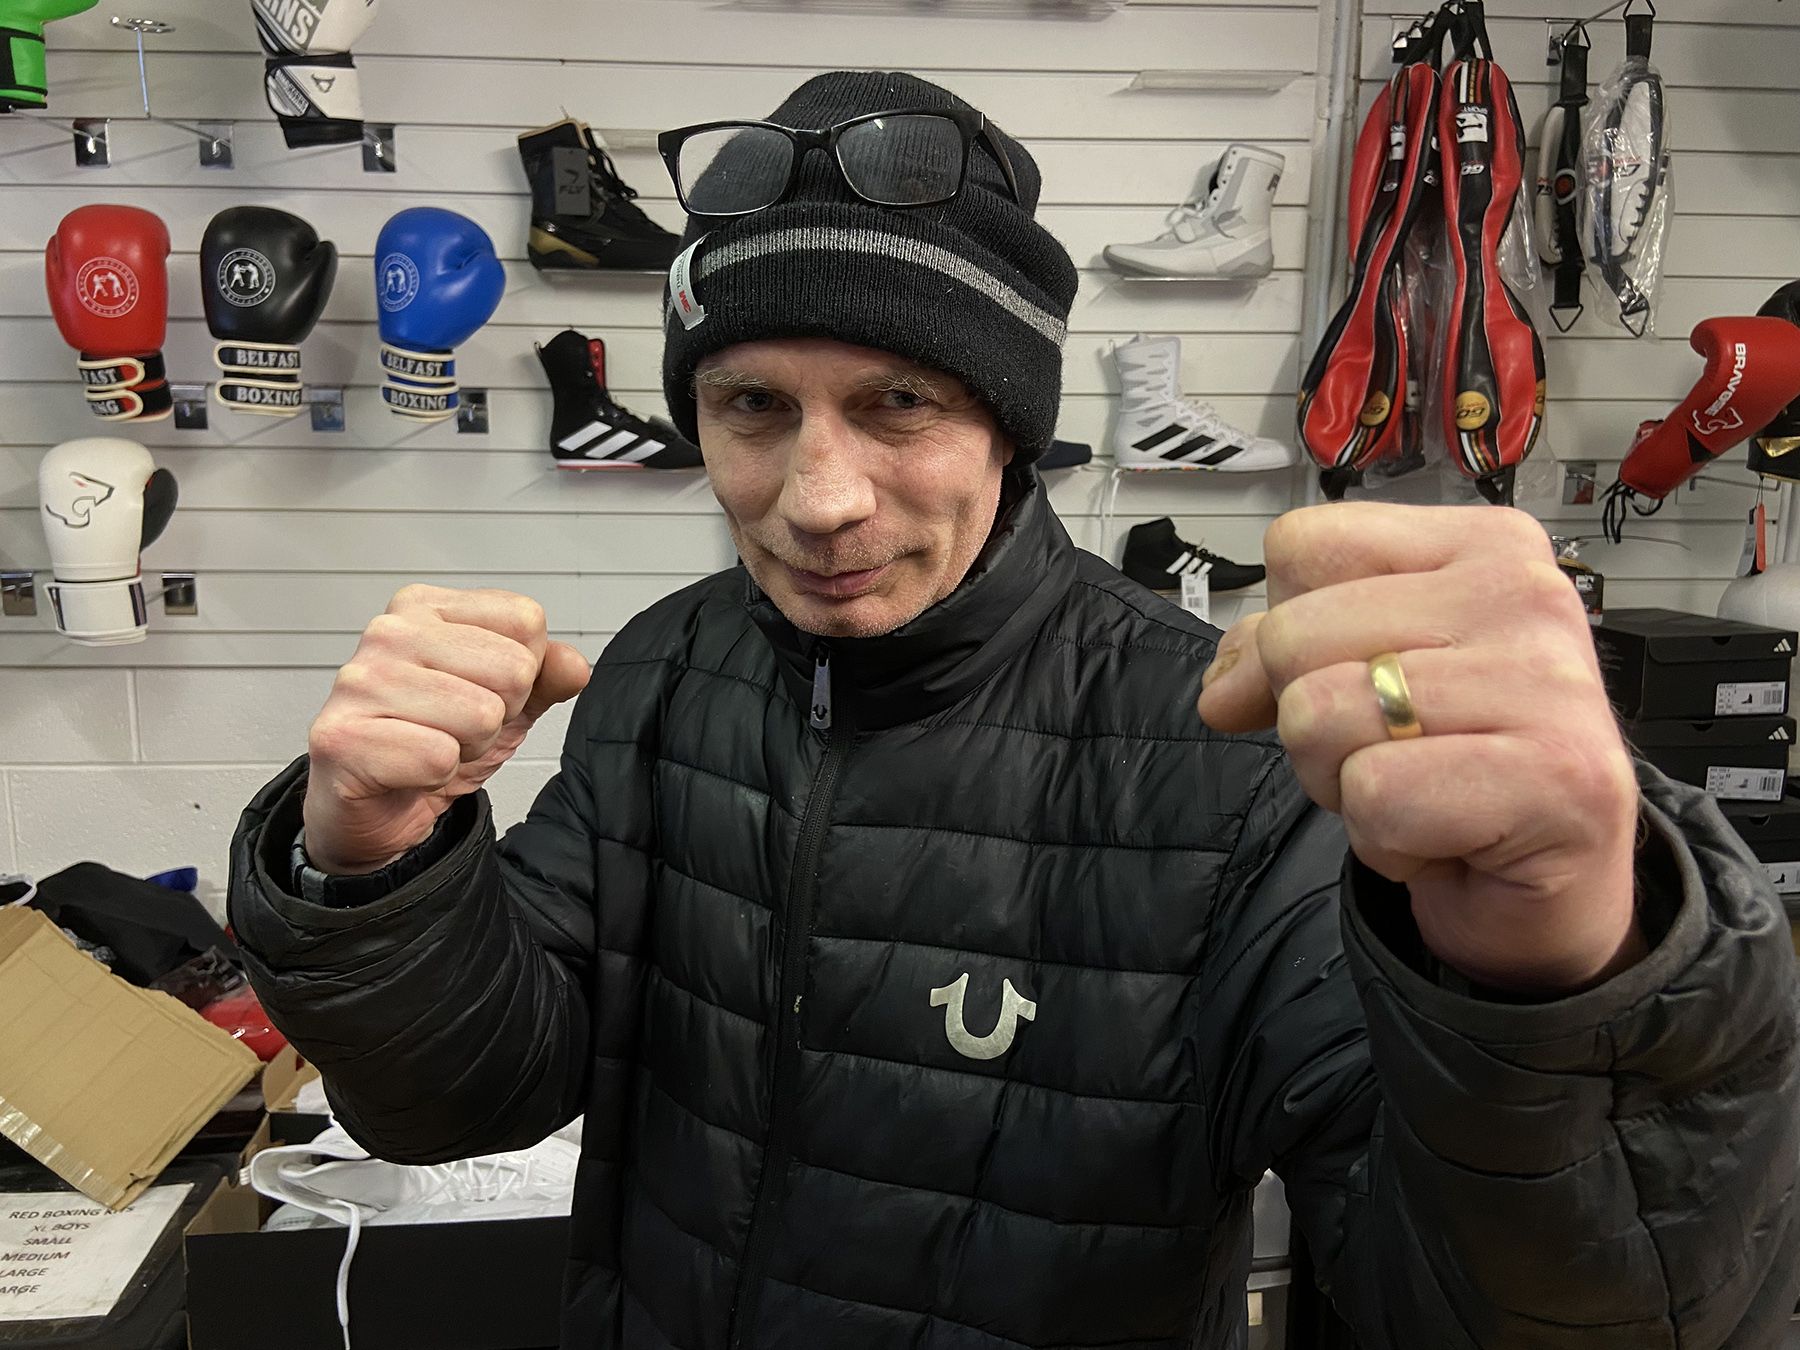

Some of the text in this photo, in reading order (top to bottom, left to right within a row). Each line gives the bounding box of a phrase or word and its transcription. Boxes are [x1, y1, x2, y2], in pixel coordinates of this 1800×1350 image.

[386, 352, 443, 376] BELFAST
[236, 386, 300, 406] BOXING
[390, 390, 448, 410] BOXING
[9, 1210, 39, 1219] RED
[42, 1208, 102, 1219] BOXING
[51, 1222, 91, 1231] BOYS
[23, 1237, 72, 1246] SMALL
[1, 1252, 70, 1261] MEDIUM
